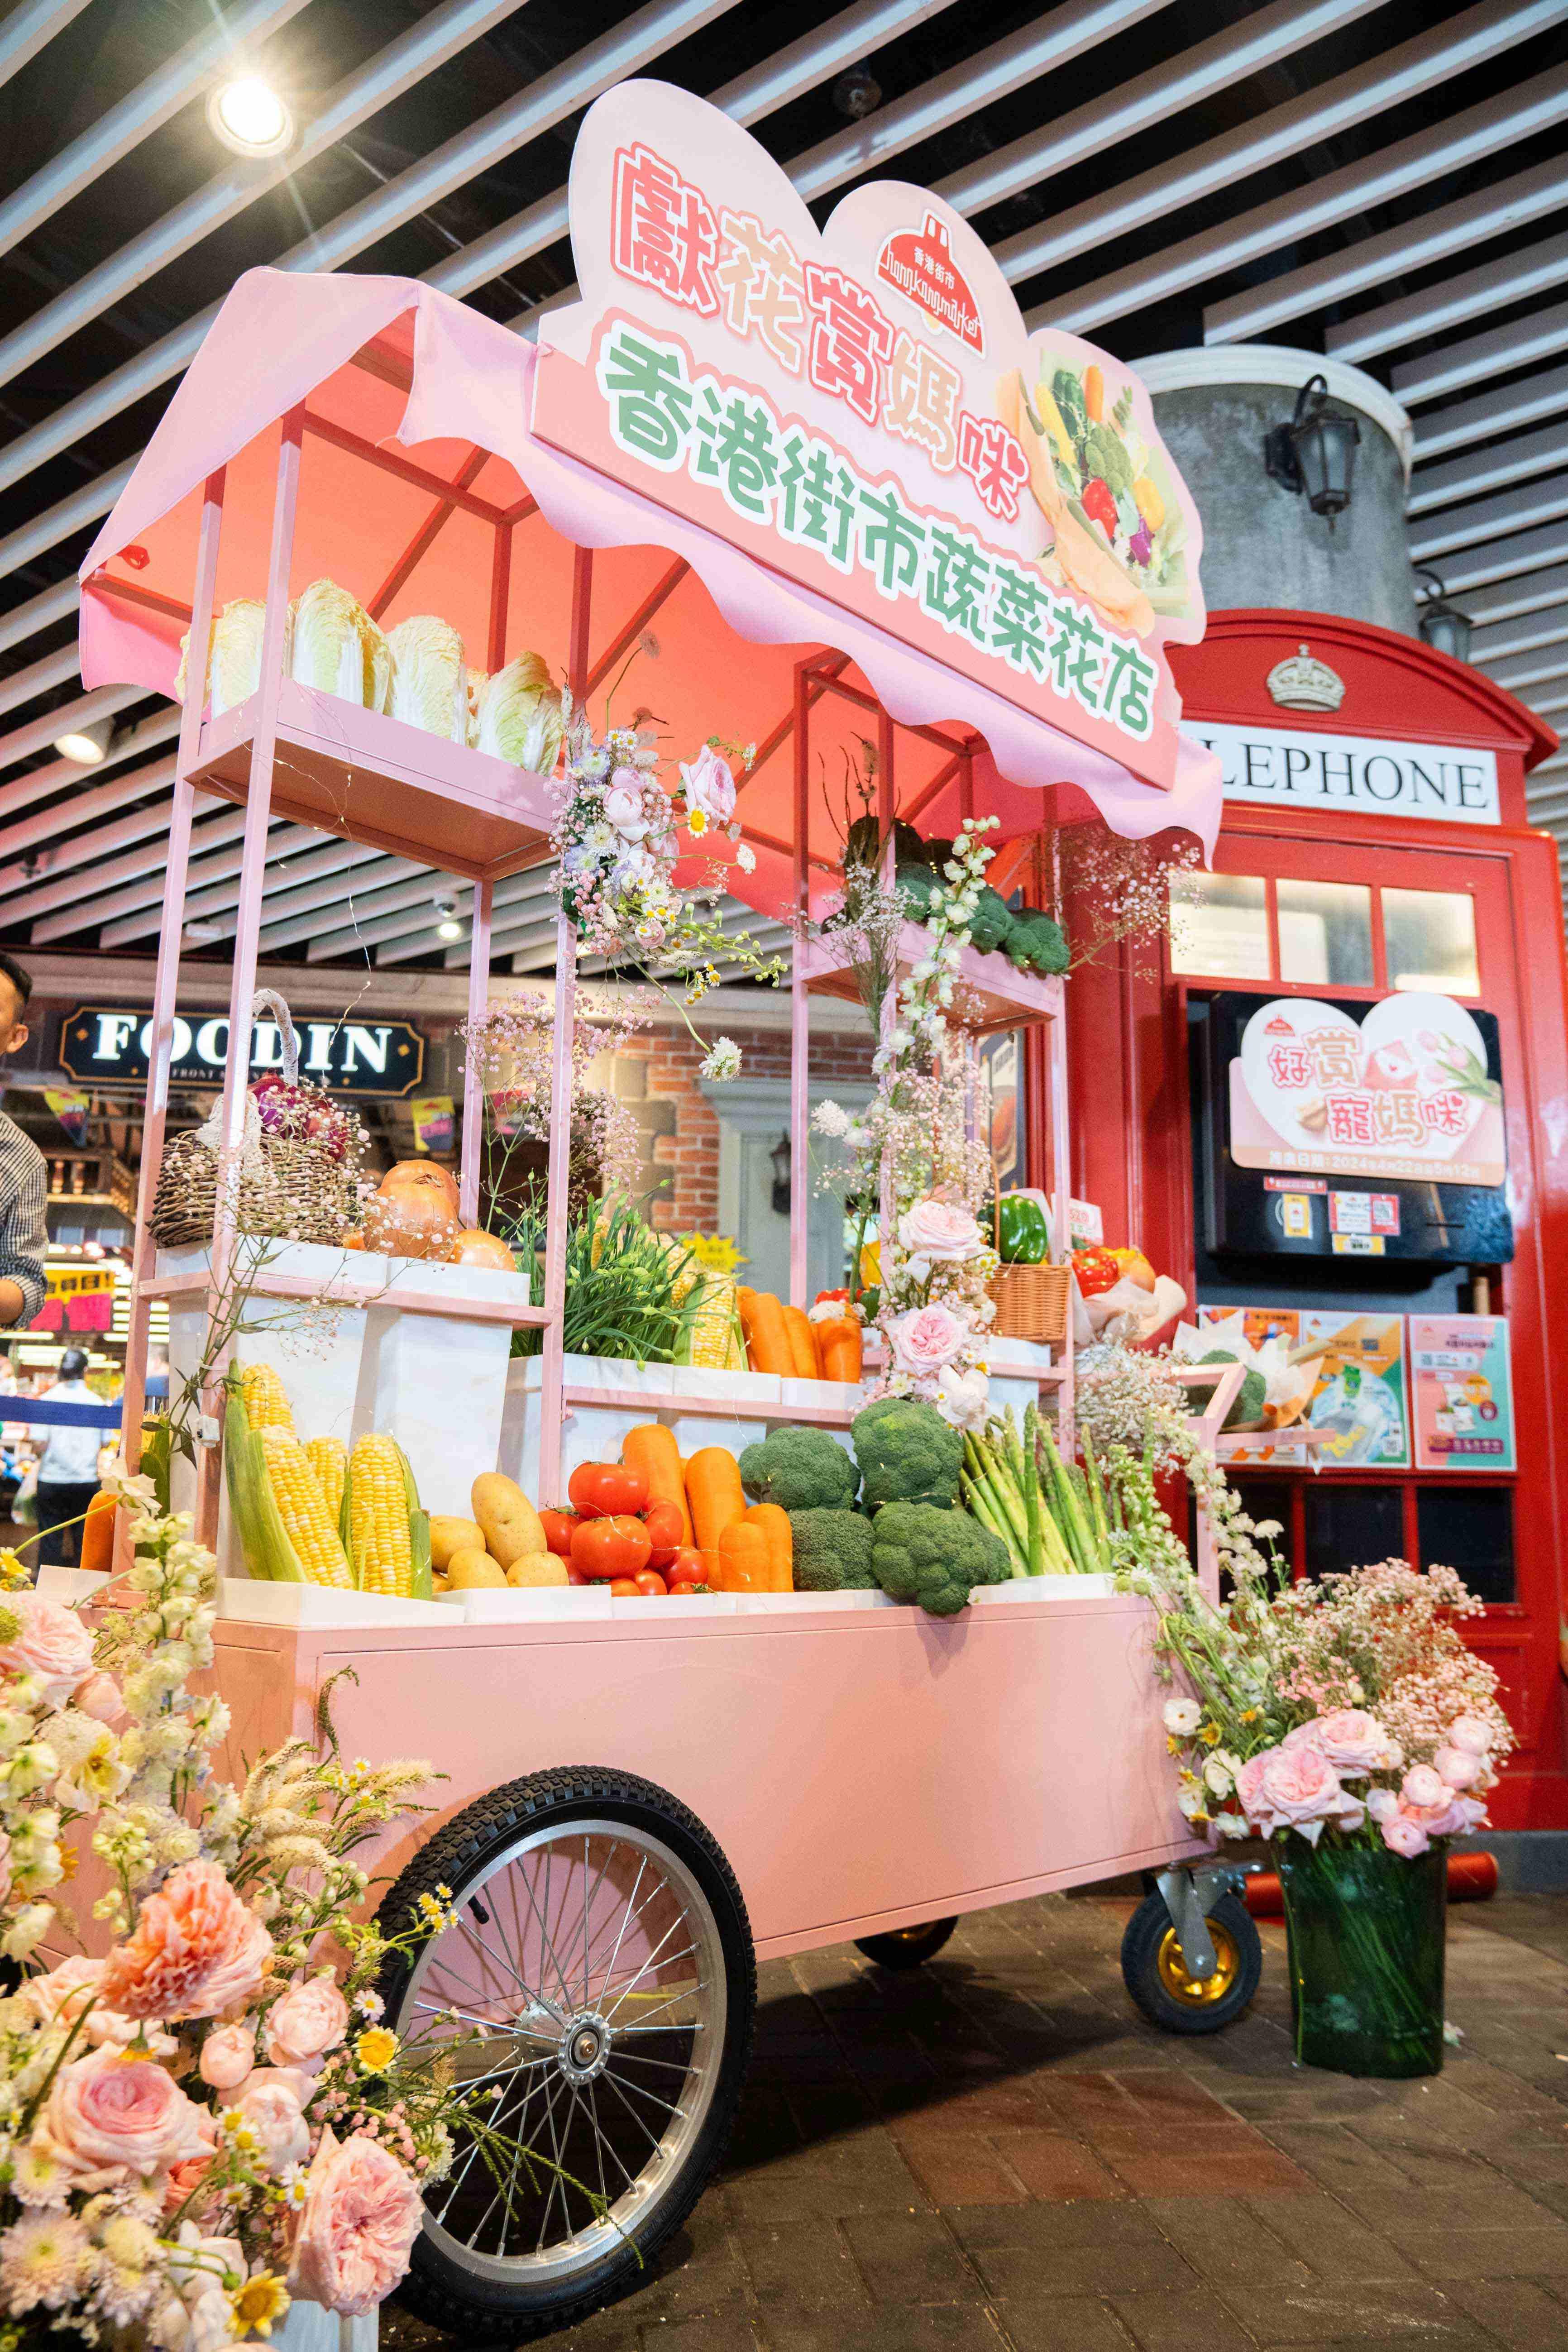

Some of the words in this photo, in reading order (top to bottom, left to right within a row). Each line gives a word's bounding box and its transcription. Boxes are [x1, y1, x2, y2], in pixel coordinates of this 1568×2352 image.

[914, 246, 956, 290] 香港街市
[604, 331, 1154, 733] 香港街市蔬菜花店
[1270, 1028, 1360, 1086] 好賞
[1327, 1090, 1466, 1145] 寵媽咪
